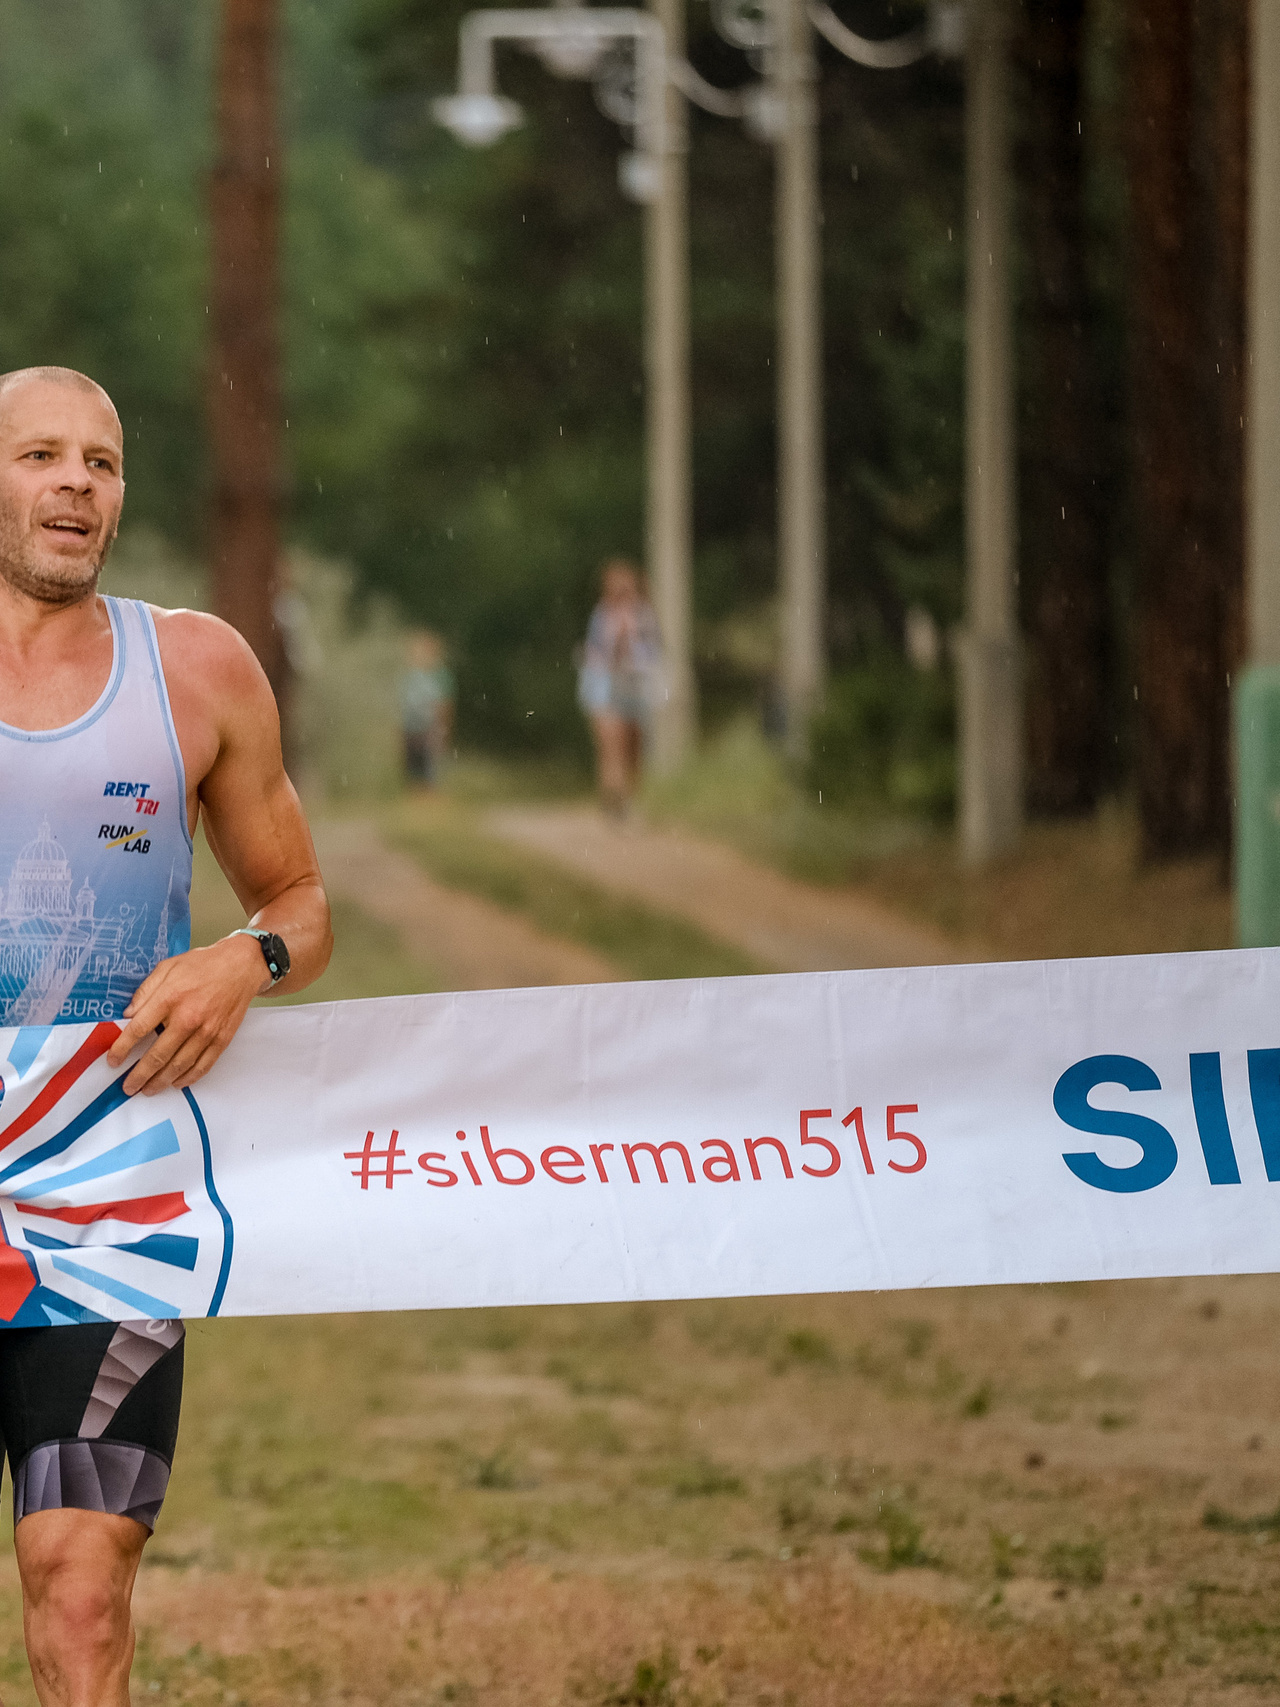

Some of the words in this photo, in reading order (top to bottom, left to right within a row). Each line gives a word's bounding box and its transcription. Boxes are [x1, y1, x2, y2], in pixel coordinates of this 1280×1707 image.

[103, 781, 150, 797] RENT
[136, 798, 160, 816] TRI
[98, 824, 134, 840] RUN
[123, 838, 151, 854] LAB
[343, 1103, 928, 1190] #siberman515
